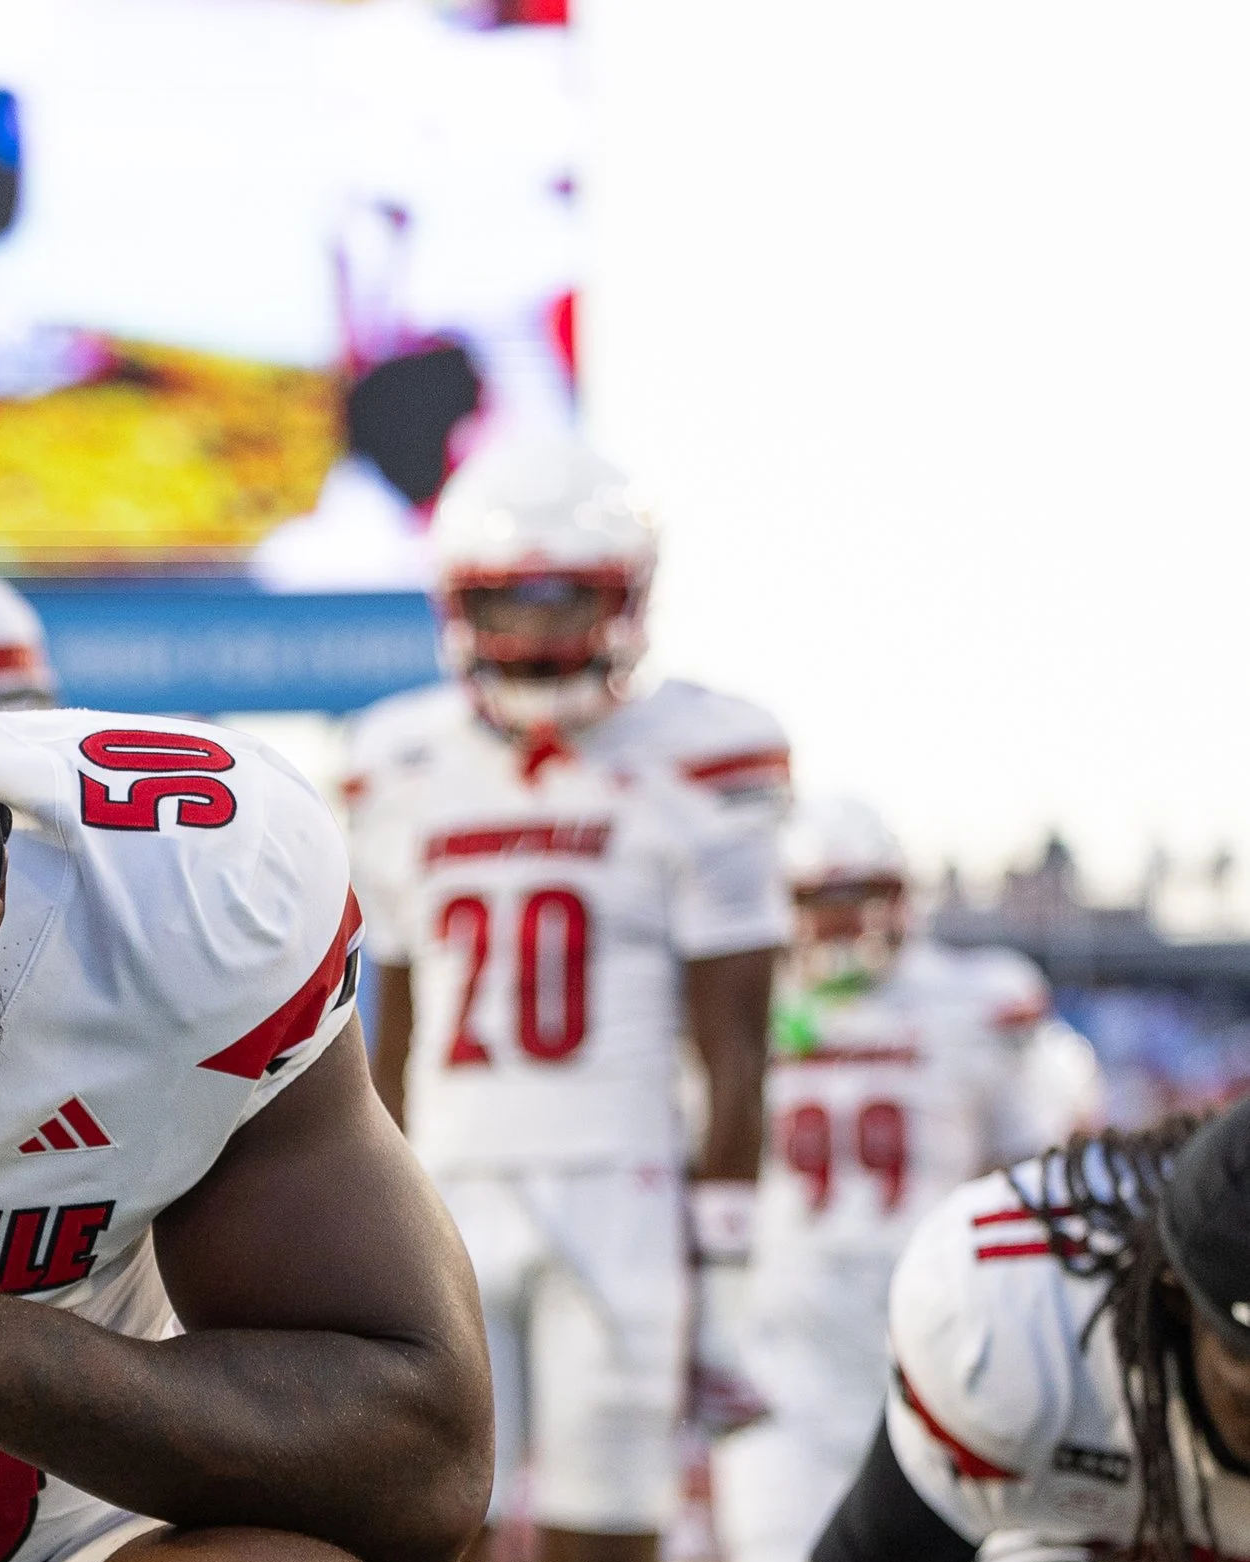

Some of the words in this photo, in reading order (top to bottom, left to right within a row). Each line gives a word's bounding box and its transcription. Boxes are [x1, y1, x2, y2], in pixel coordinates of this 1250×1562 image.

[78, 728, 238, 832] 50
[433, 884, 587, 1068] 20
[782, 1100, 906, 1212] 99
